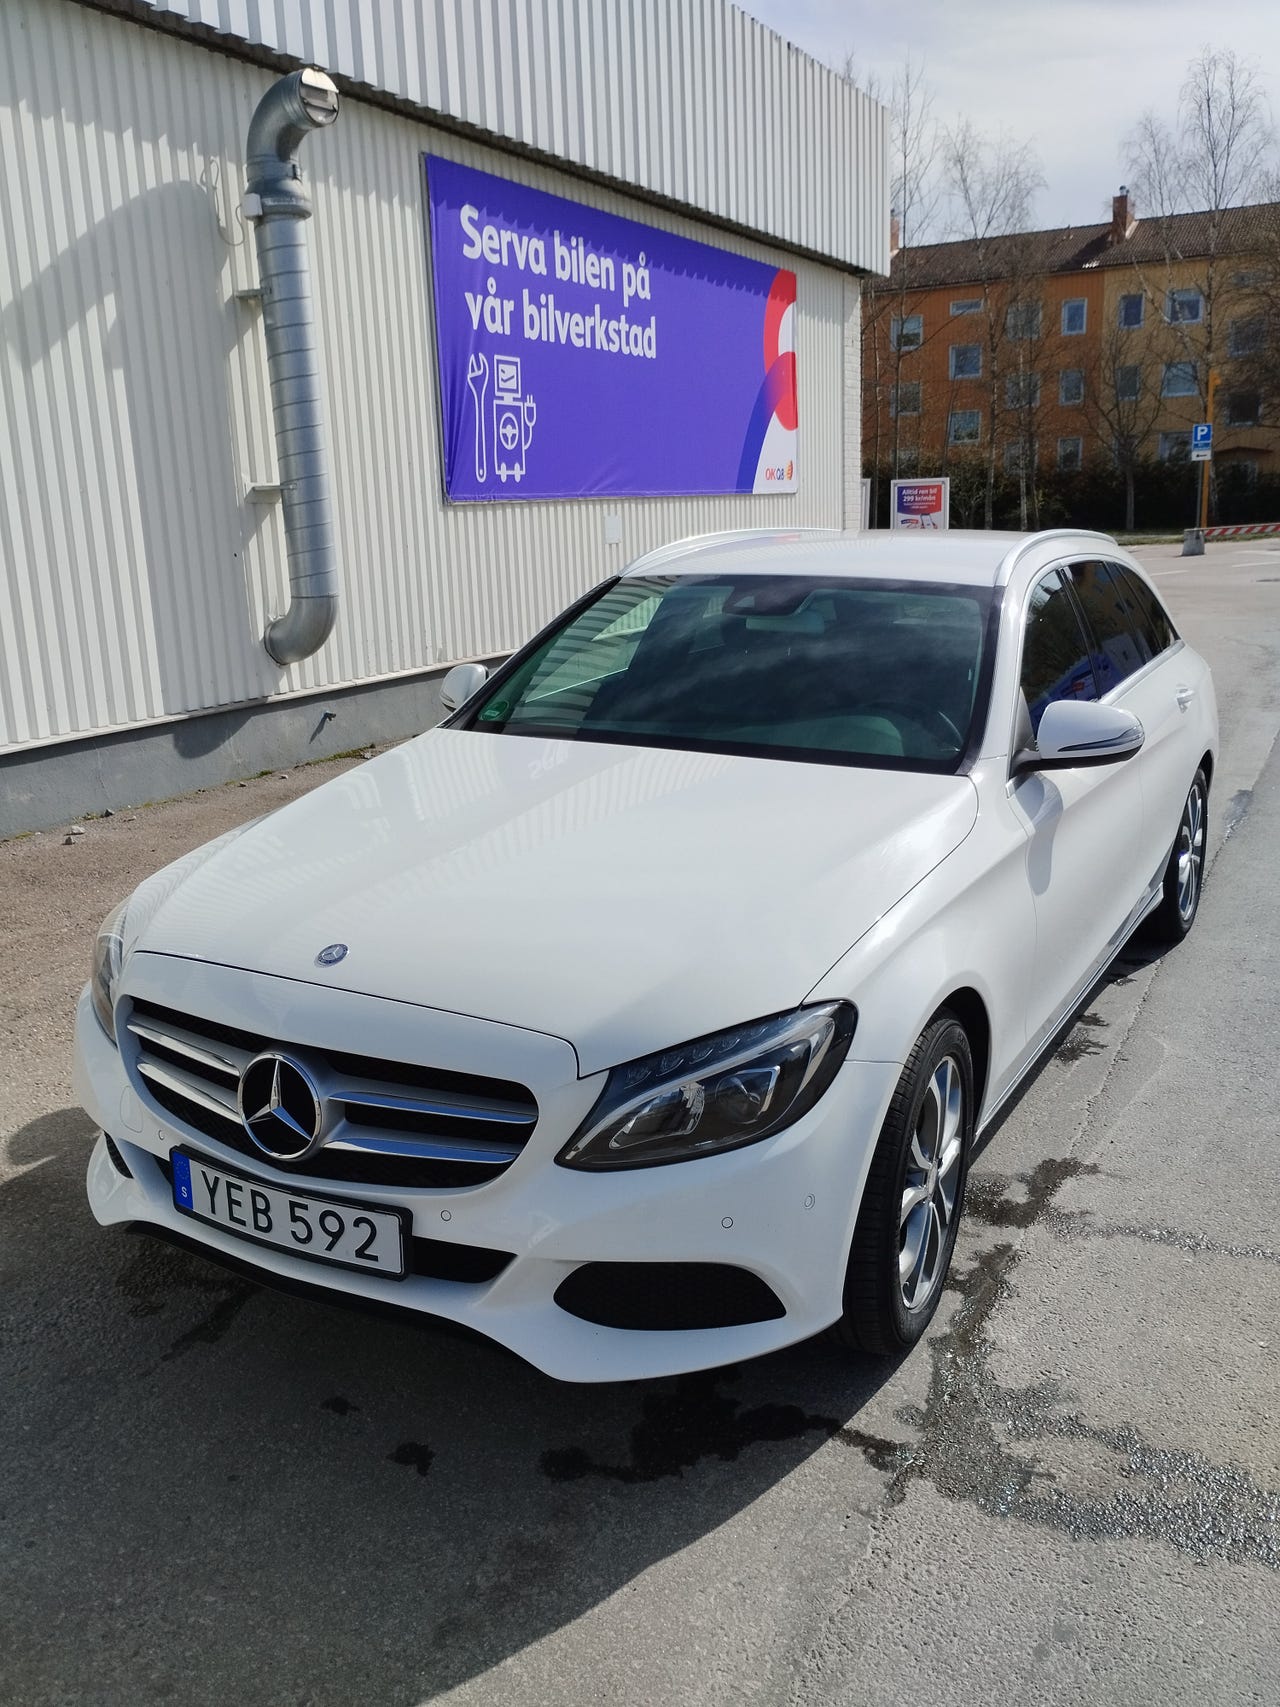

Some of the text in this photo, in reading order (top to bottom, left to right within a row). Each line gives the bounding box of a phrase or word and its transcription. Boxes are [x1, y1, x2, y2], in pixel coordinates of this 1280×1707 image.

[460, 203, 651, 307] Serva bilen på
[465, 277, 657, 359] vår bilverkstad
[1197, 426, 1208, 440] P
[181, 1186, 188, 1198] S
[201, 1170, 379, 1262] YEB 592
